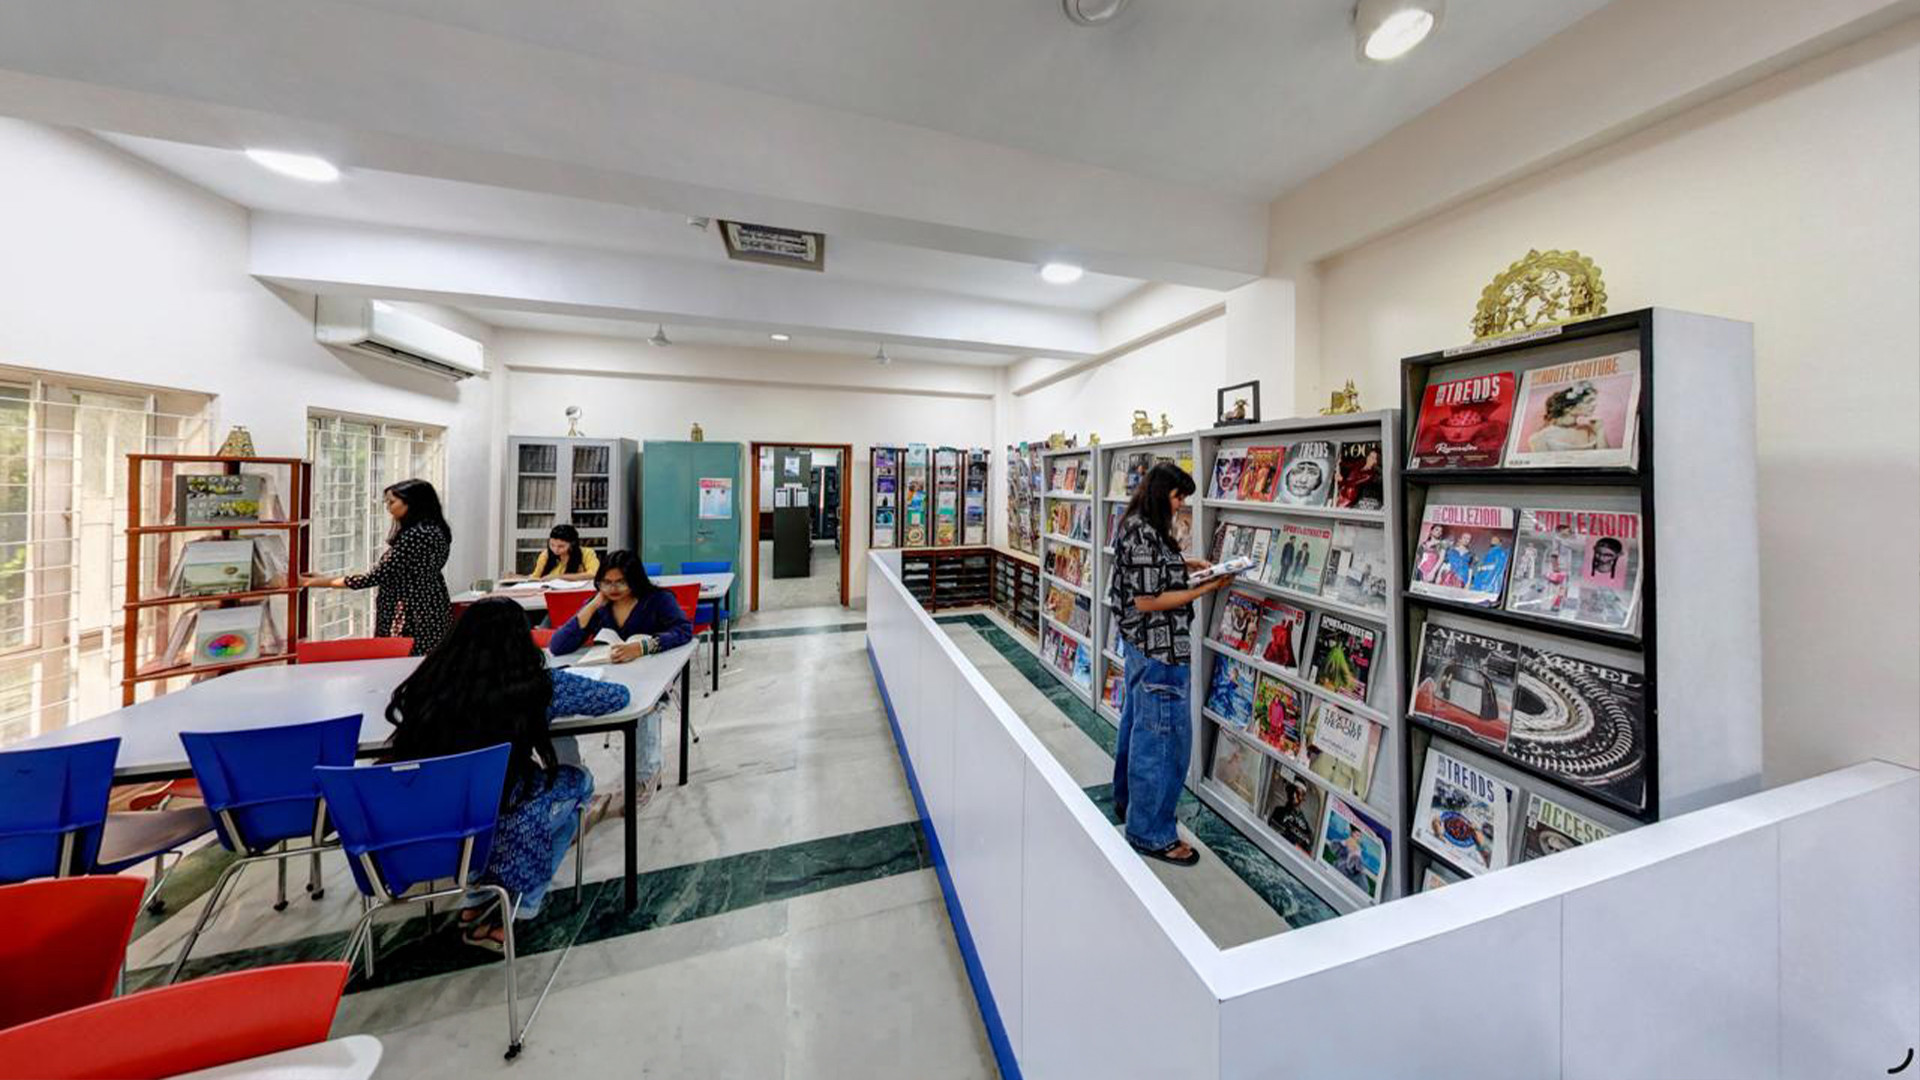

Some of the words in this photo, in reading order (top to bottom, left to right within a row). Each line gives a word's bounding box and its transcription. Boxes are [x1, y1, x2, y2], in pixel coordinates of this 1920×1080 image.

[1446, 376, 1500, 405] TRENDS
[1441, 506, 1502, 527] COLLEZIONI
[1535, 510, 1639, 538] COLLEZIONI
[1432, 626, 1513, 655] ARPEL
[1541, 650, 1642, 688] ARPEL
[1323, 716, 1362, 741] REPORT
[1324, 708, 1362, 732] TEXTILE
[1445, 759, 1495, 803] TRENDS
[1540, 800, 1612, 843] ACCES
